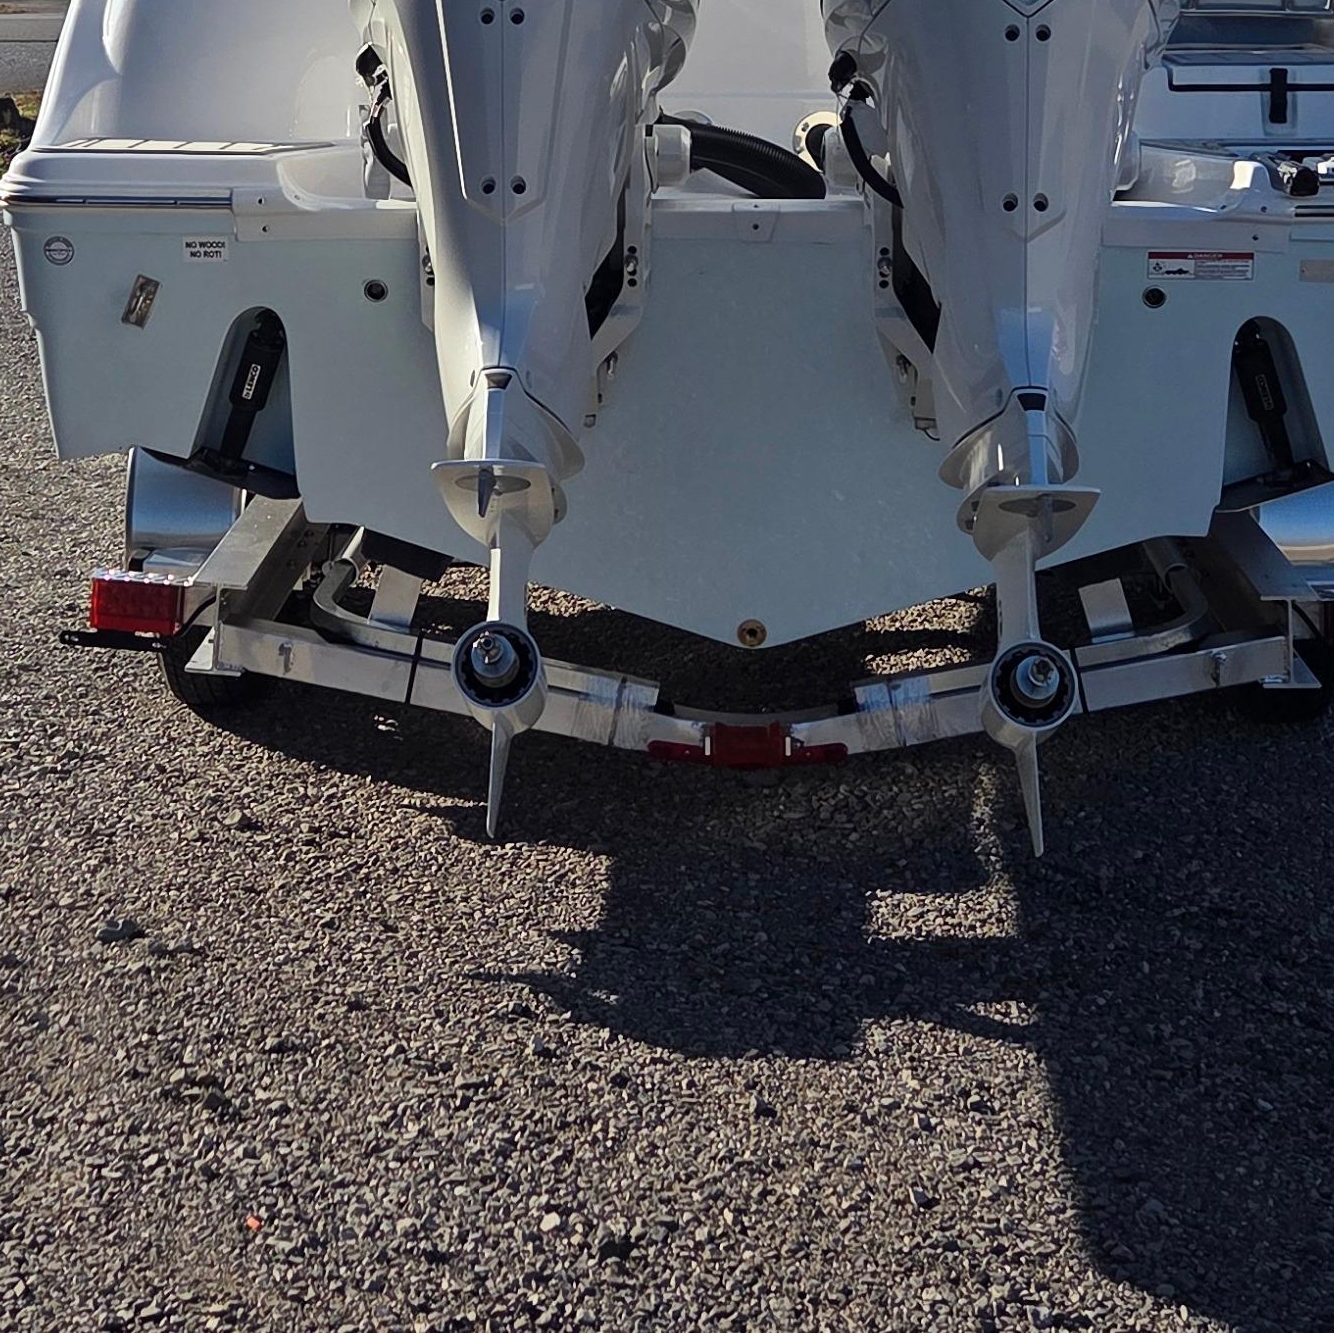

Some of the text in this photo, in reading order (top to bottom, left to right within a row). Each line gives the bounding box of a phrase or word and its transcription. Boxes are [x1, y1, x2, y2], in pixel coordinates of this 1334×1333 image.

[185, 241, 226, 249] NO WOOD!
[189, 250, 222, 258] NO ROT!
[245, 366, 259, 392] LENCO
